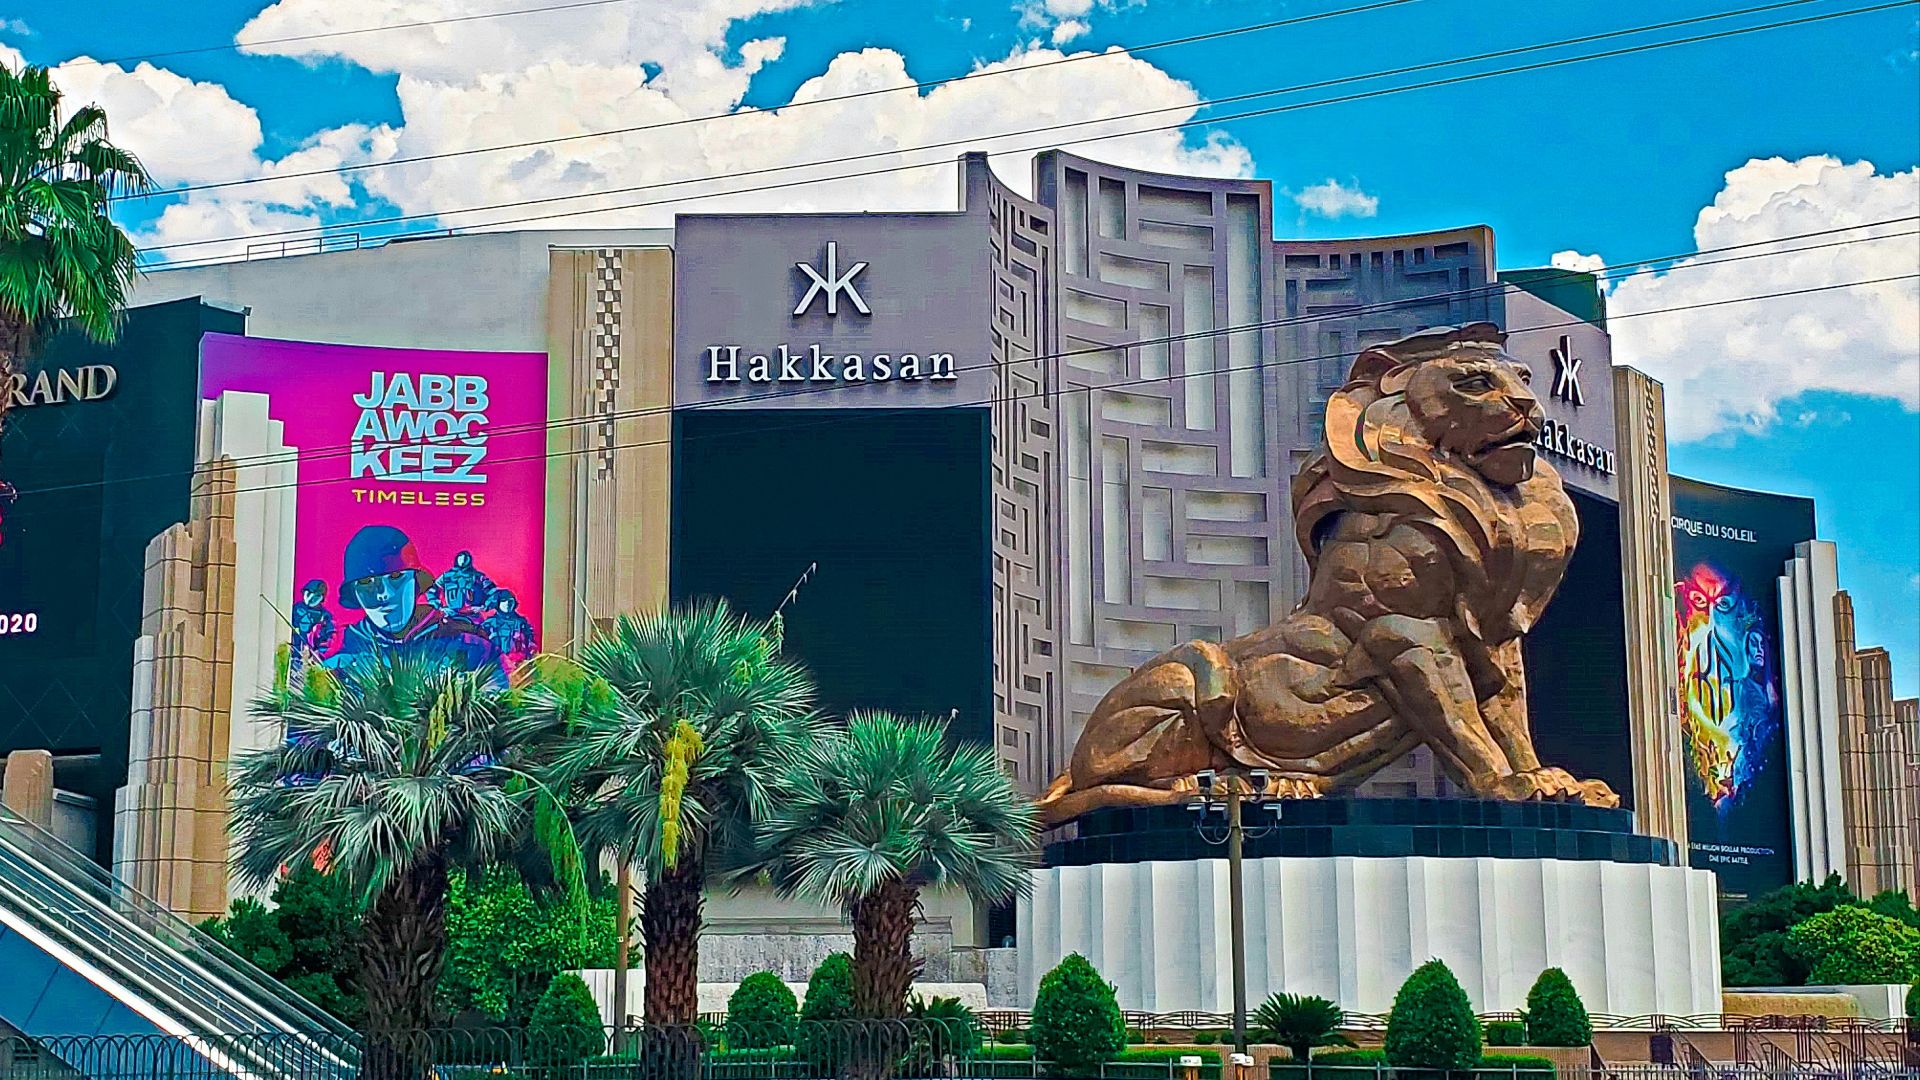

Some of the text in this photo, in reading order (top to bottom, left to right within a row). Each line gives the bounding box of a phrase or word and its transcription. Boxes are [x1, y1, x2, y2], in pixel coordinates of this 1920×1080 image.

[706, 343, 958, 382] Hakkasan
[4, 365, 117, 407] RAND
[352, 371, 489, 412] JABB
[351, 409, 490, 445] AWOC
[351, 441, 487, 483] KEEZ
[1533, 419, 1617, 475] akkasan
[352, 489, 485, 506] TIMELESS
[1671, 515, 1757, 542] CIRQUE DU SOLEIL
[0, 612, 38, 634] 020
